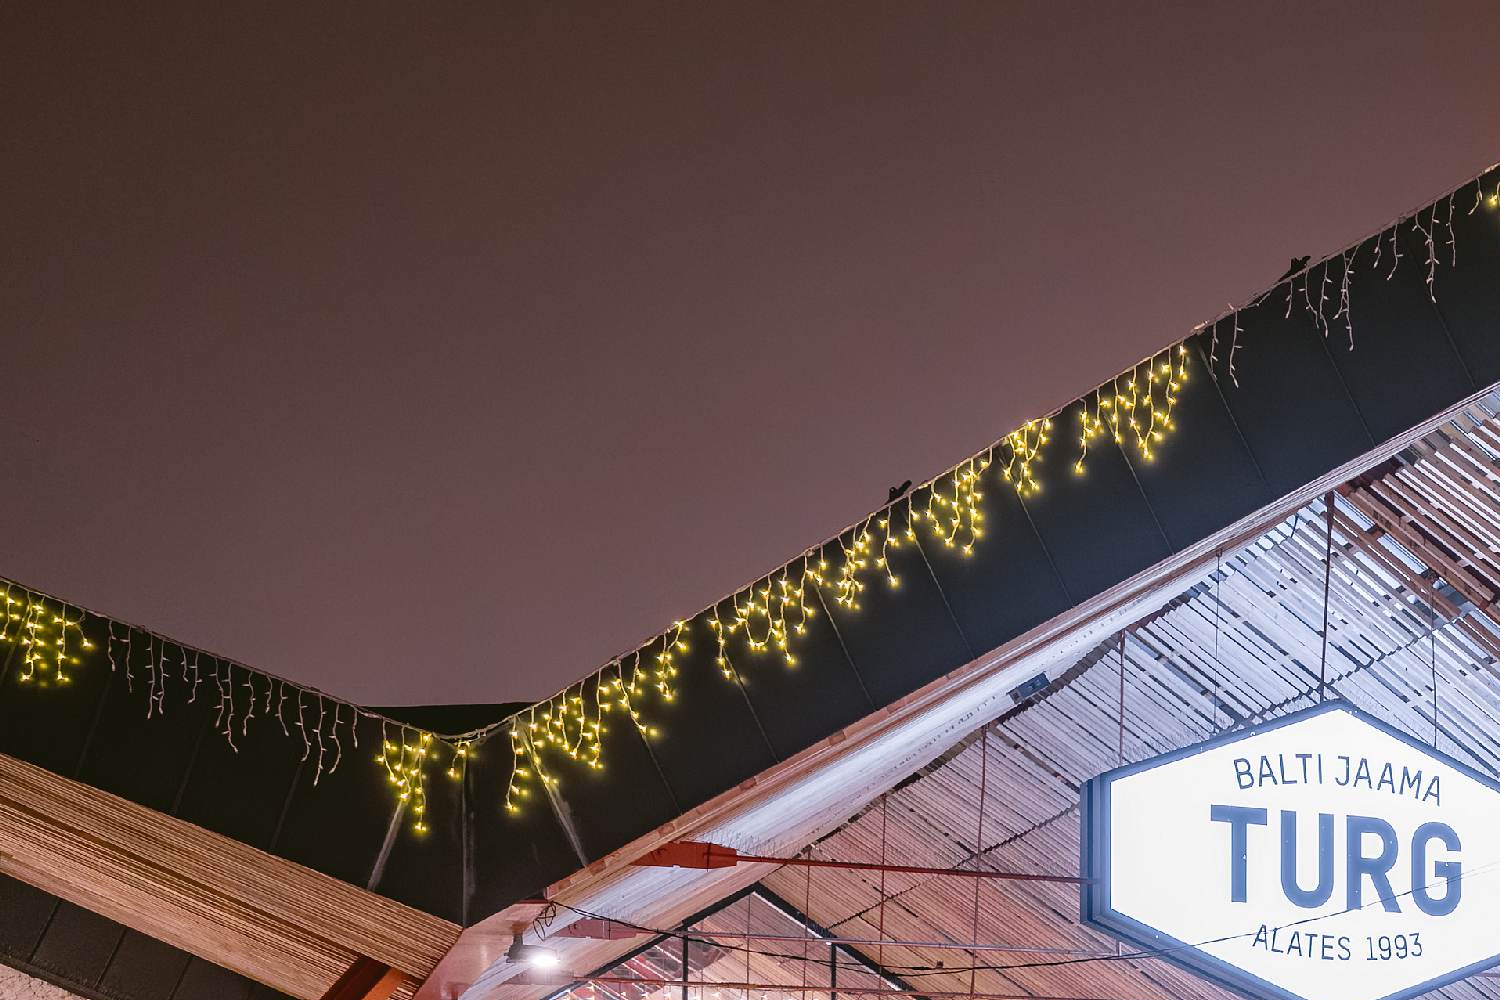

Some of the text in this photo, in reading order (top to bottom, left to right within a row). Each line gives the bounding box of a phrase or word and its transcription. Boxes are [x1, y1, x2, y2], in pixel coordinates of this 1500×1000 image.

[1233, 753, 1441, 807] BALTI JAAMA
[1210, 804, 1462, 917] TURG
[1252, 924, 1423, 961] ALATES 1993
